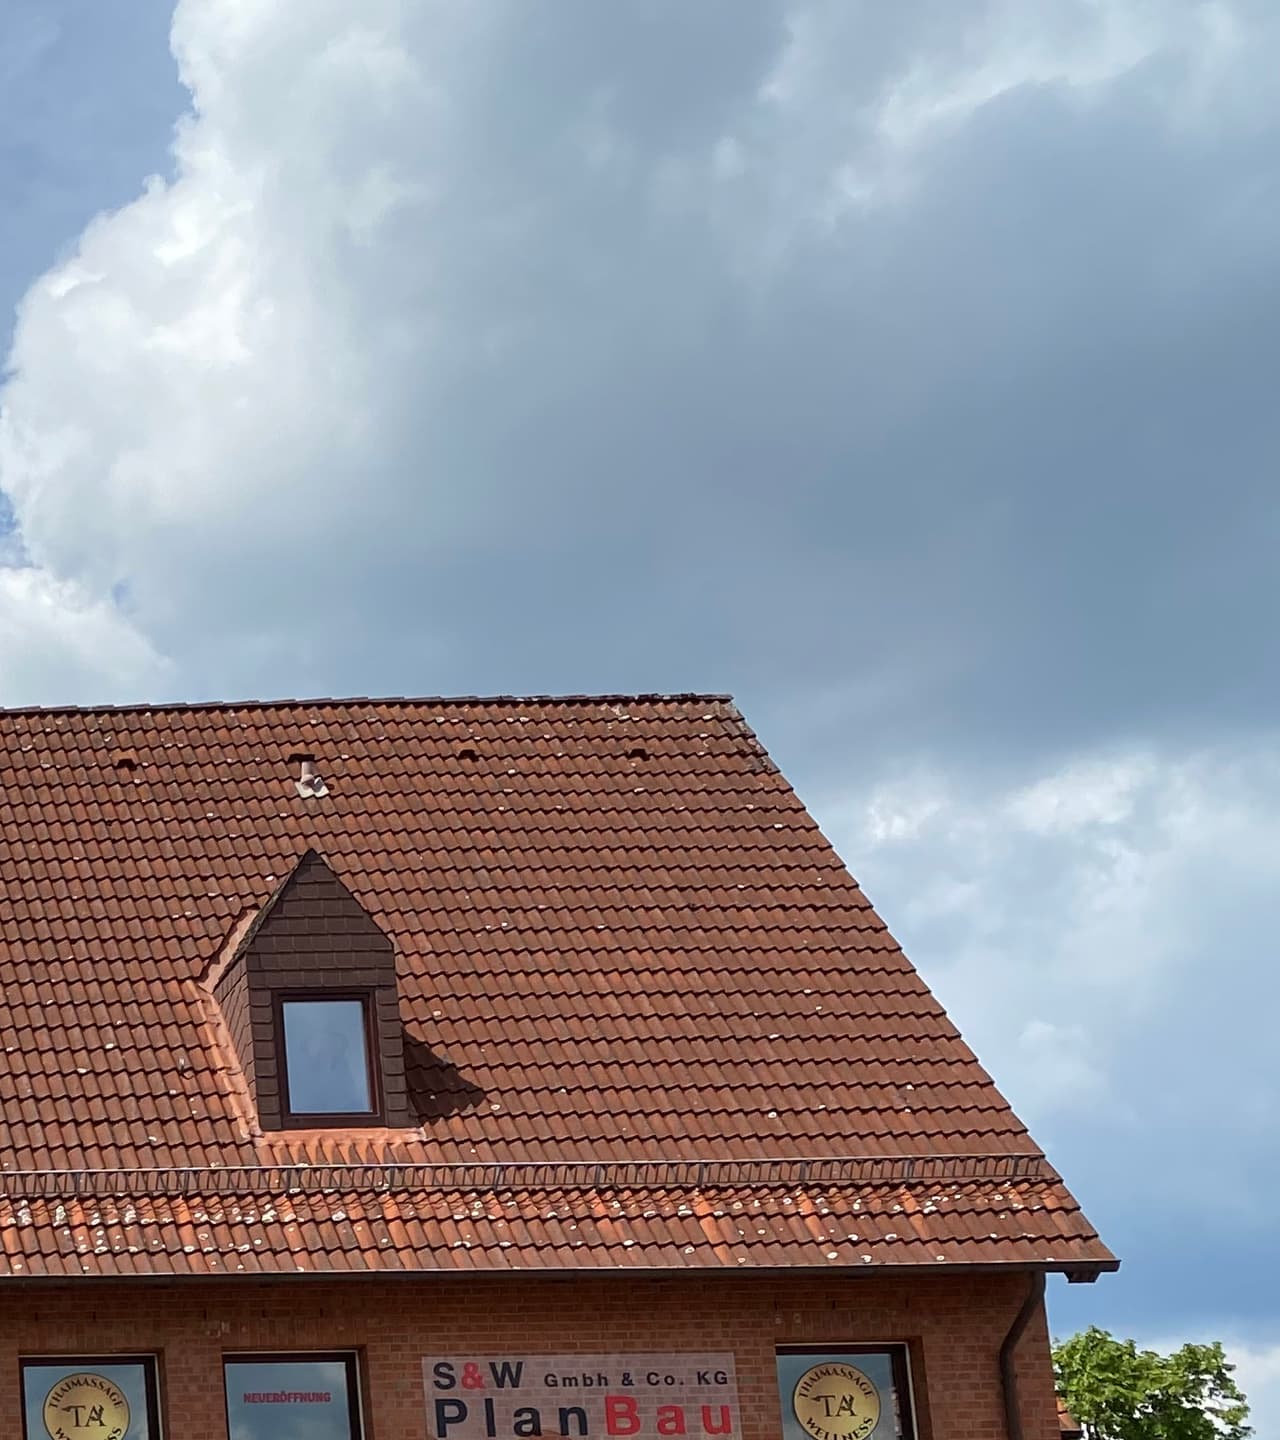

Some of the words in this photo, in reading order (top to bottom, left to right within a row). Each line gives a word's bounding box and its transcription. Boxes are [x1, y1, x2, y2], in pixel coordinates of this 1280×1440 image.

[432, 1361, 523, 1390] S&W
[543, 1371, 609, 1388] Gmbh
[621, 1372, 635, 1387] &
[646, 1371, 685, 1387] Co.
[696, 1370, 729, 1386] KG
[799, 1367, 875, 1399] THAIMASSAGE
[48, 1377, 124, 1409] THAIMASSAGE
[243, 1390, 333, 1404] NEUERÖFFNUNG
